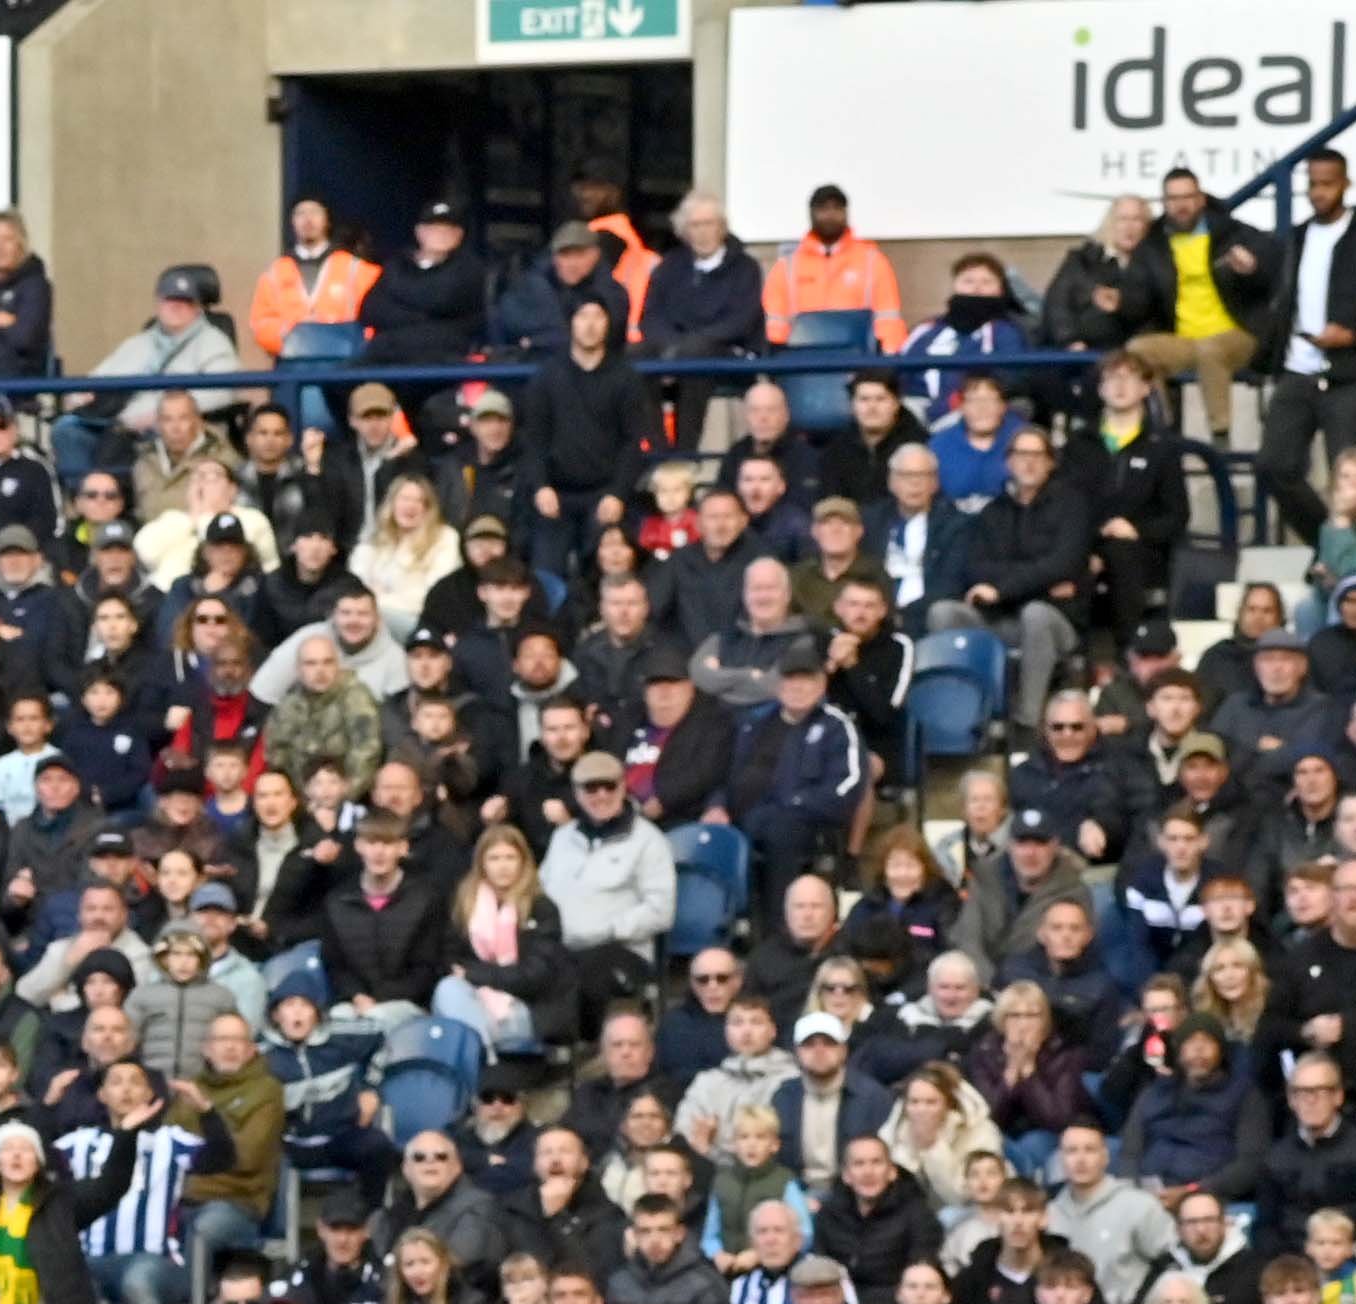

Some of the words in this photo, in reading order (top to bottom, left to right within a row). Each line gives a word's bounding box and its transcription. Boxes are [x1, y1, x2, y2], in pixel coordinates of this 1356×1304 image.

[520, 6, 576, 36] EXIT
[1072, 19, 1346, 131] ideal
[1100, 147, 1288, 180] HEATIN
